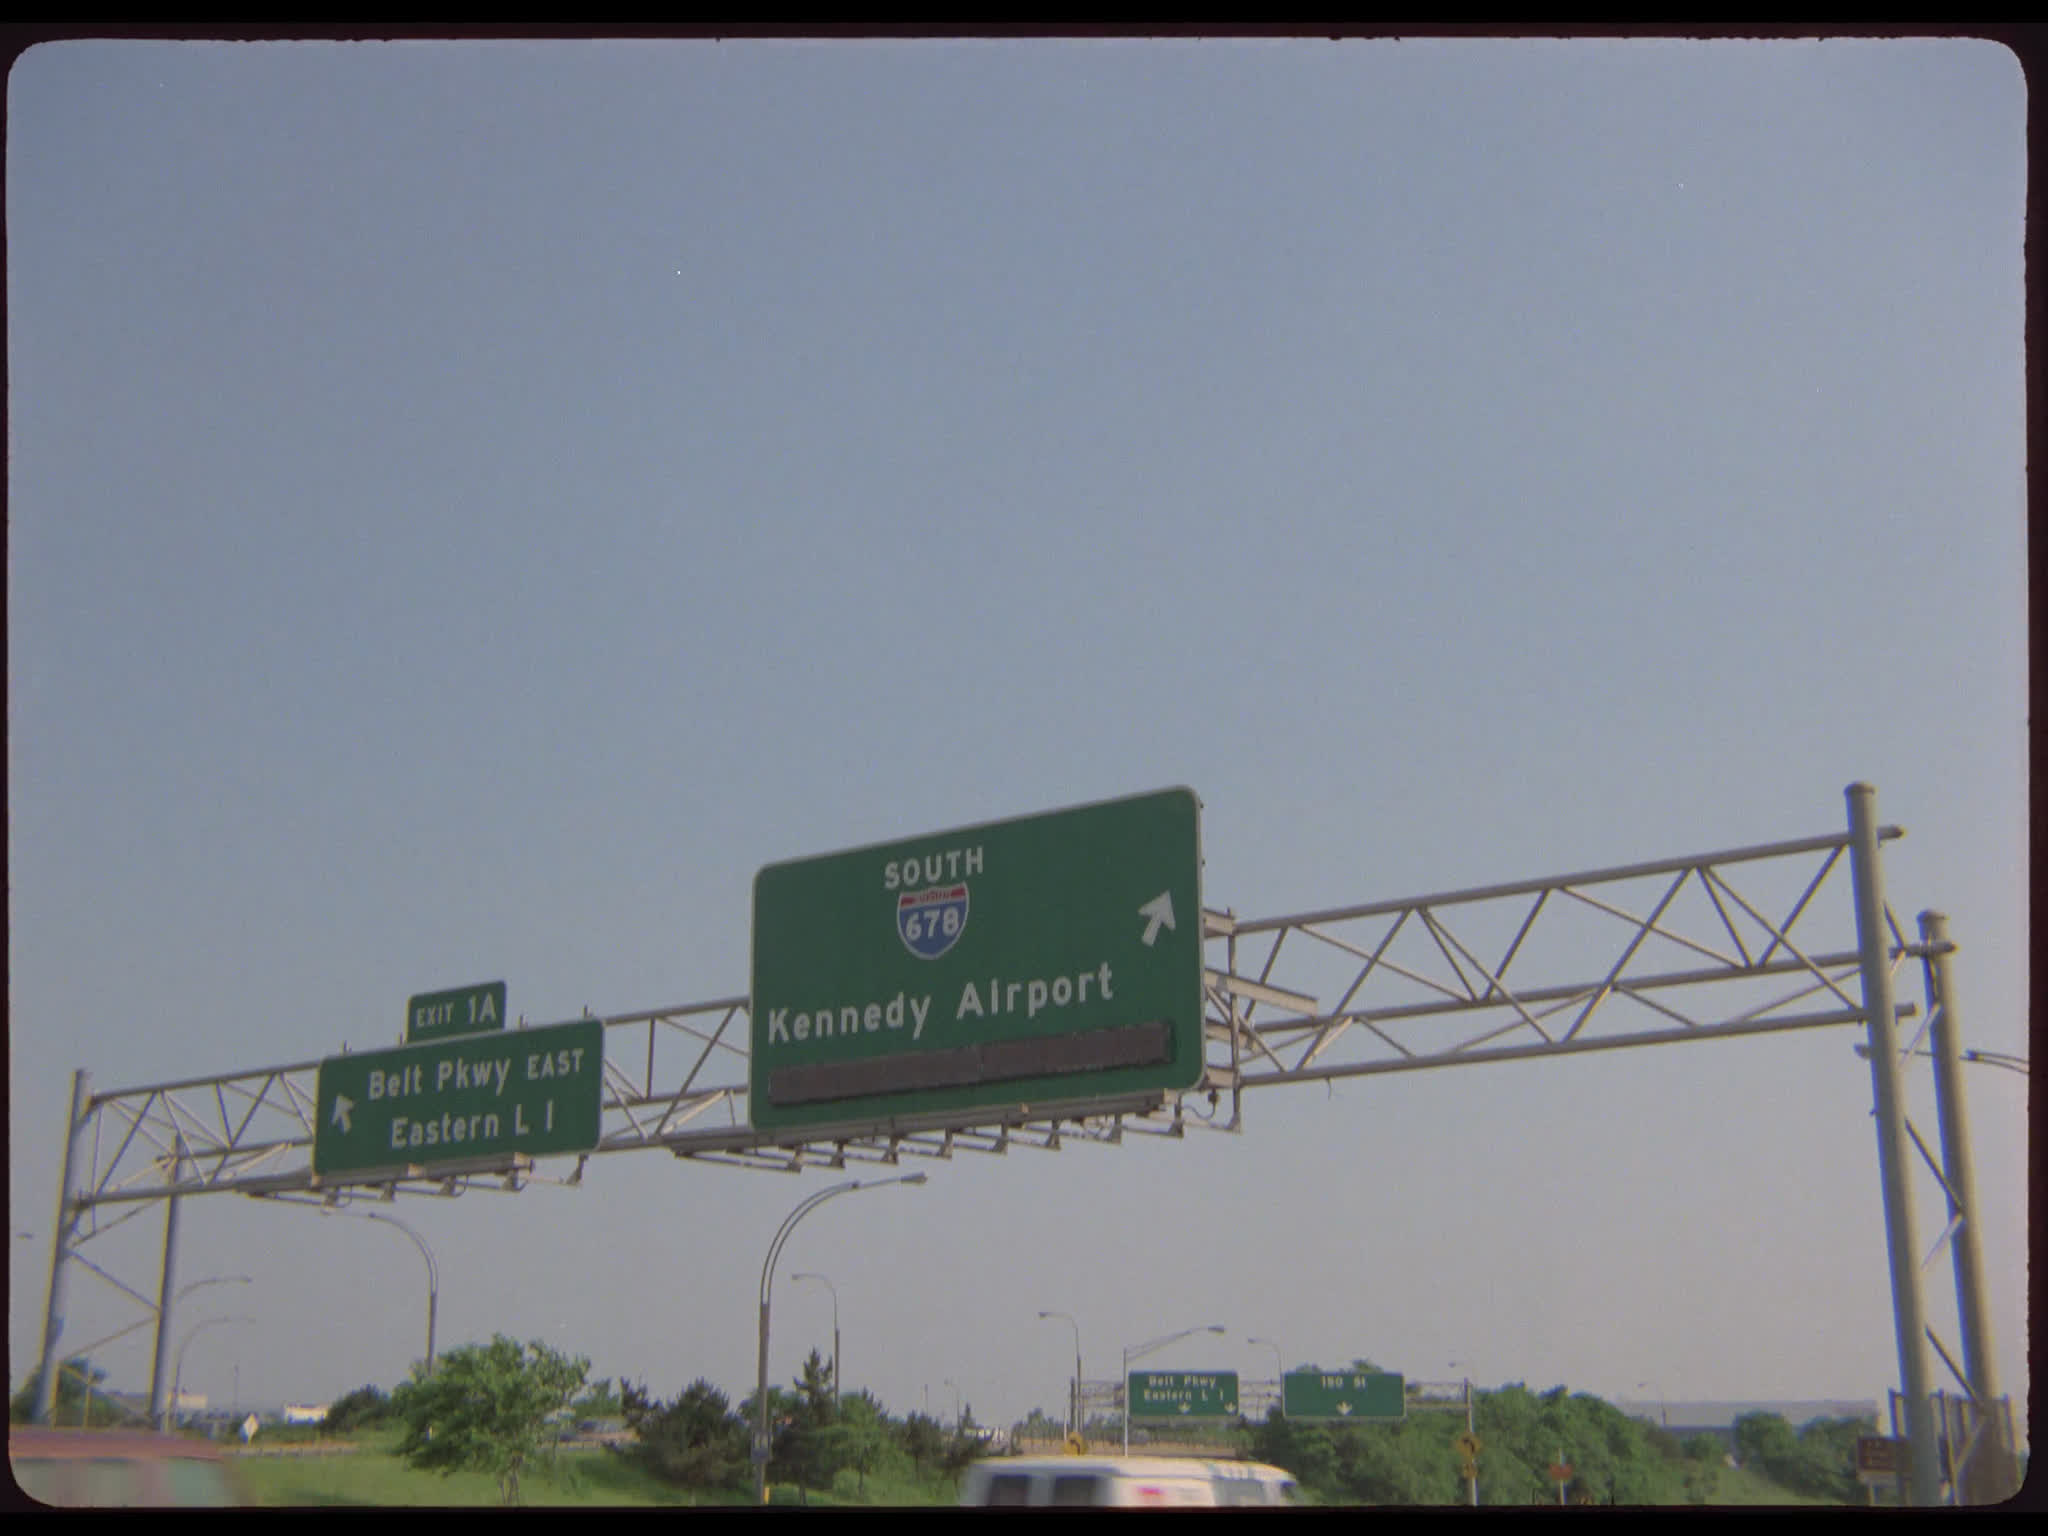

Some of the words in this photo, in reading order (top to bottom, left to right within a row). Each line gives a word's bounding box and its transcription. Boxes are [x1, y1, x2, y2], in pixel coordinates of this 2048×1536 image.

[884, 846, 985, 890] SOUTH
[906, 906, 960, 942] 678
[416, 1003, 454, 1028] EXIT
[469, 992, 497, 1024] 1A
[768, 993, 931, 1044] Kennedy
[956, 962, 1113, 1020] Airport
[368, 1063, 423, 1100] Belt
[437, 1058, 511, 1096] Pkwy
[527, 1048, 585, 1081] EAST
[391, 1112, 499, 1148] Eastern
[515, 1104, 529, 1135] L
[545, 1100, 554, 1133] I
